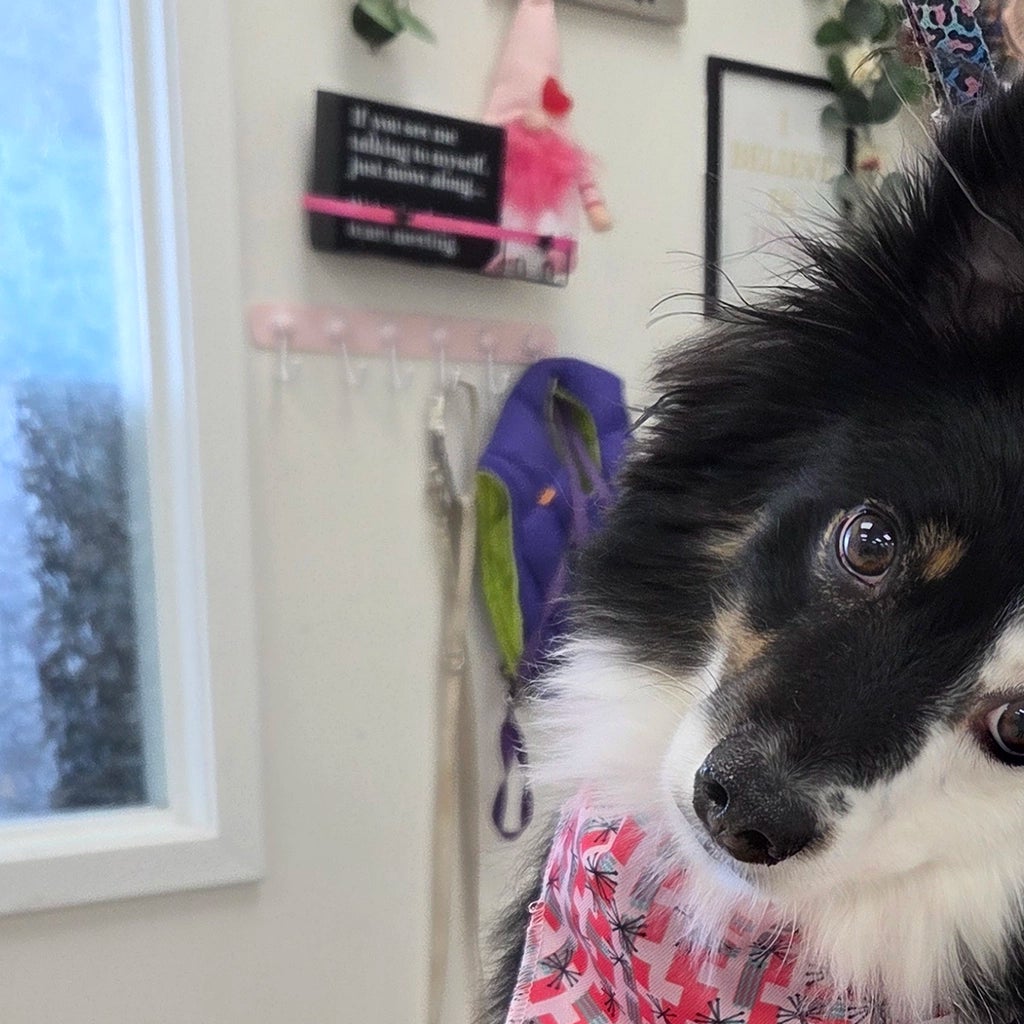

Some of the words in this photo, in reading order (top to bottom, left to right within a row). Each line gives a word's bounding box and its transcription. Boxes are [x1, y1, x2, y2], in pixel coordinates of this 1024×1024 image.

[351, 105, 368, 128] If
[373, 116, 402, 134] you
[349, 131, 411, 163] talking
[413, 145, 431, 162] to
[386, 165, 425, 185] move
